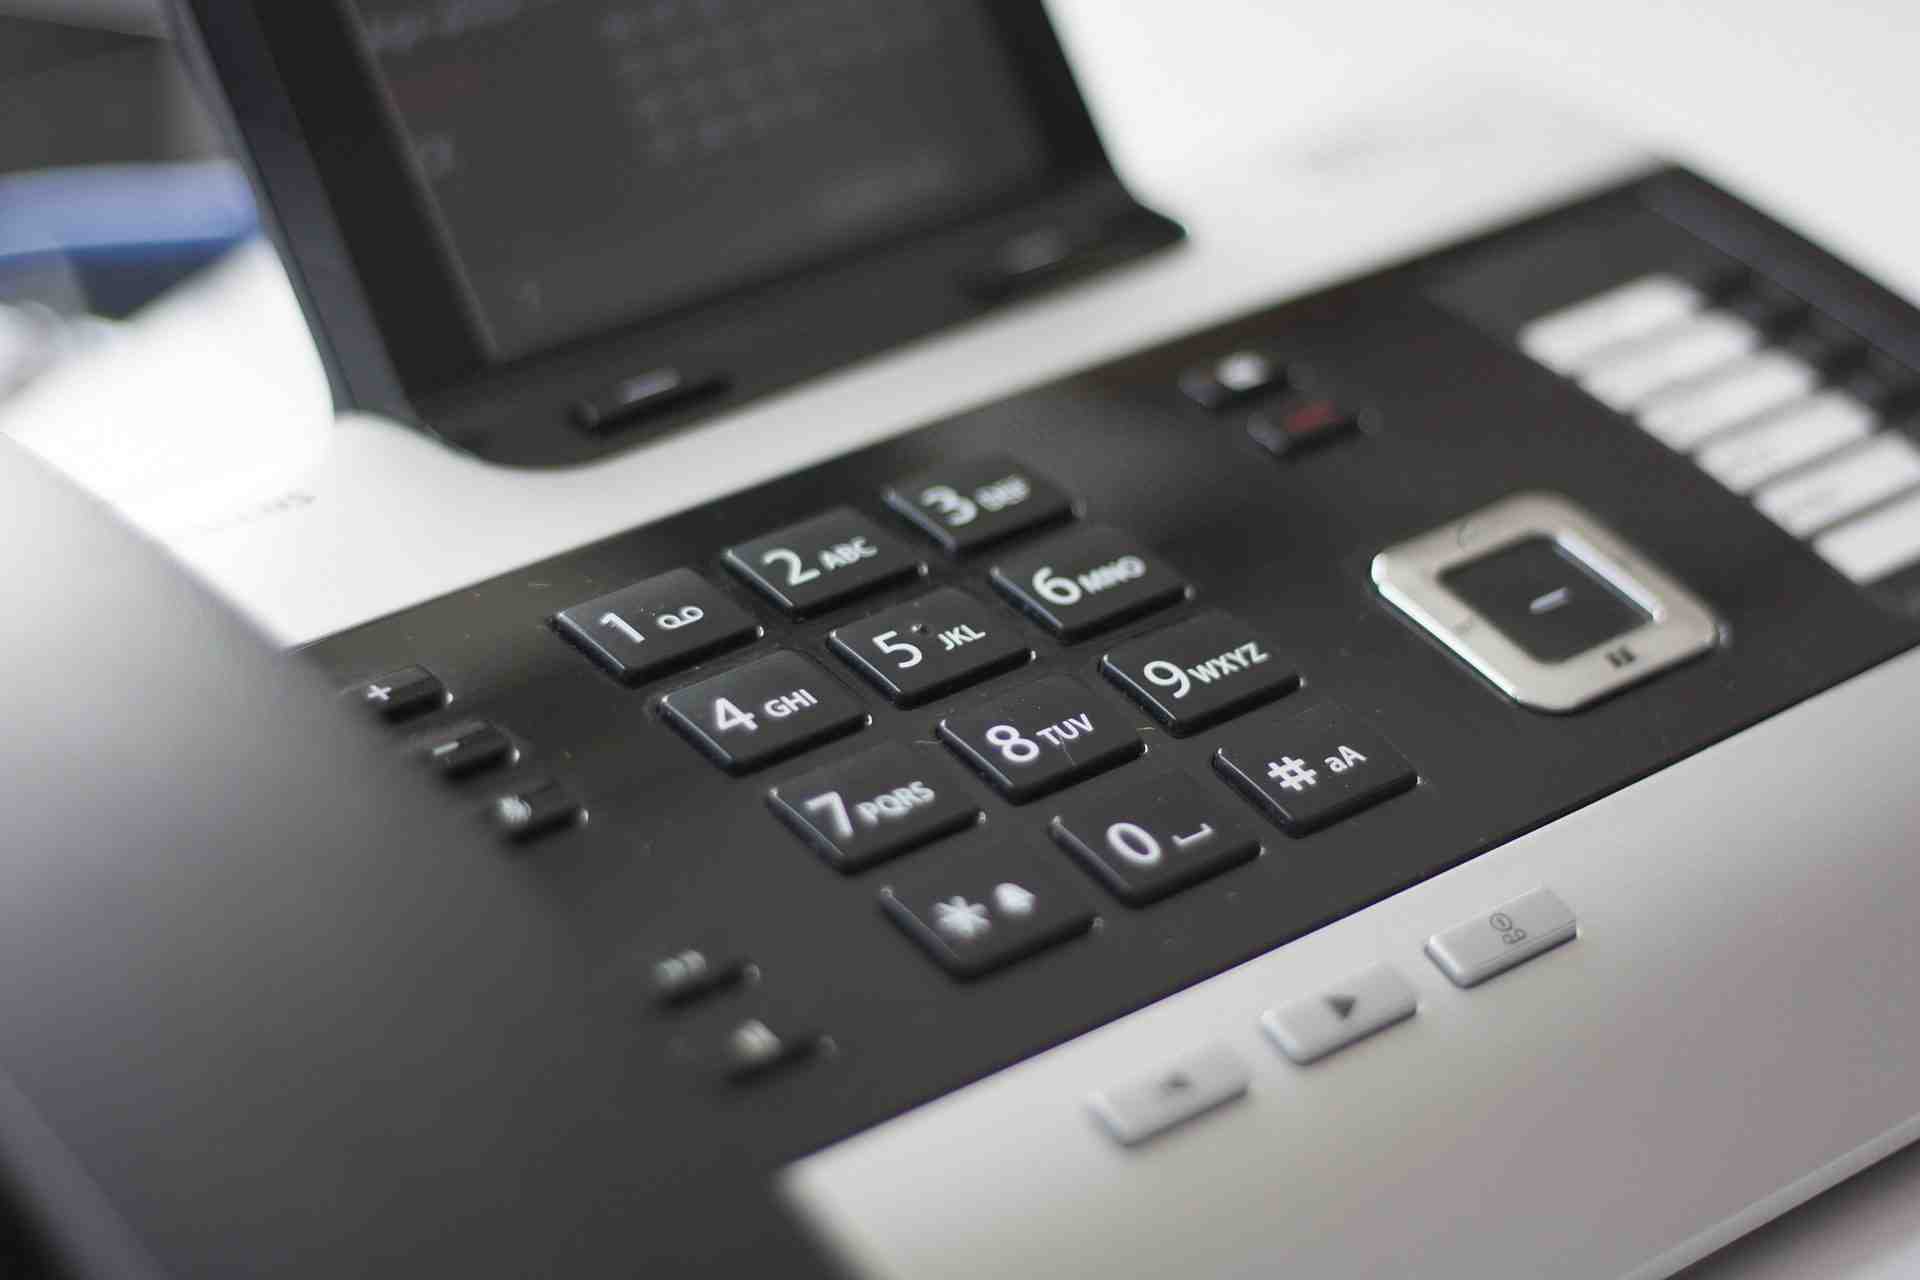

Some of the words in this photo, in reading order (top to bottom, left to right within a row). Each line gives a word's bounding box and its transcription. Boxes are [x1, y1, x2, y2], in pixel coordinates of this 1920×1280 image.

[923, 487, 976, 525] 3
[762, 549, 821, 586] 2
[818, 536, 878, 571] ABC
[1031, 567, 1080, 606] 6
[600, 612, 645, 643] 1
[872, 630, 922, 670] 5
[938, 625, 986, 651] JKL
[1143, 660, 1190, 699] 9
[1187, 641, 1269, 684] WXYZ
[715, 698, 758, 731] 4
[764, 689, 818, 718] GHI
[986, 725, 1039, 764] 8
[1038, 713, 1094, 745] TUV
[1325, 745, 1367, 773] aA
[807, 791, 853, 839] 7
[856, 780, 935, 823] PQRS
[1107, 822, 1162, 865] 0
